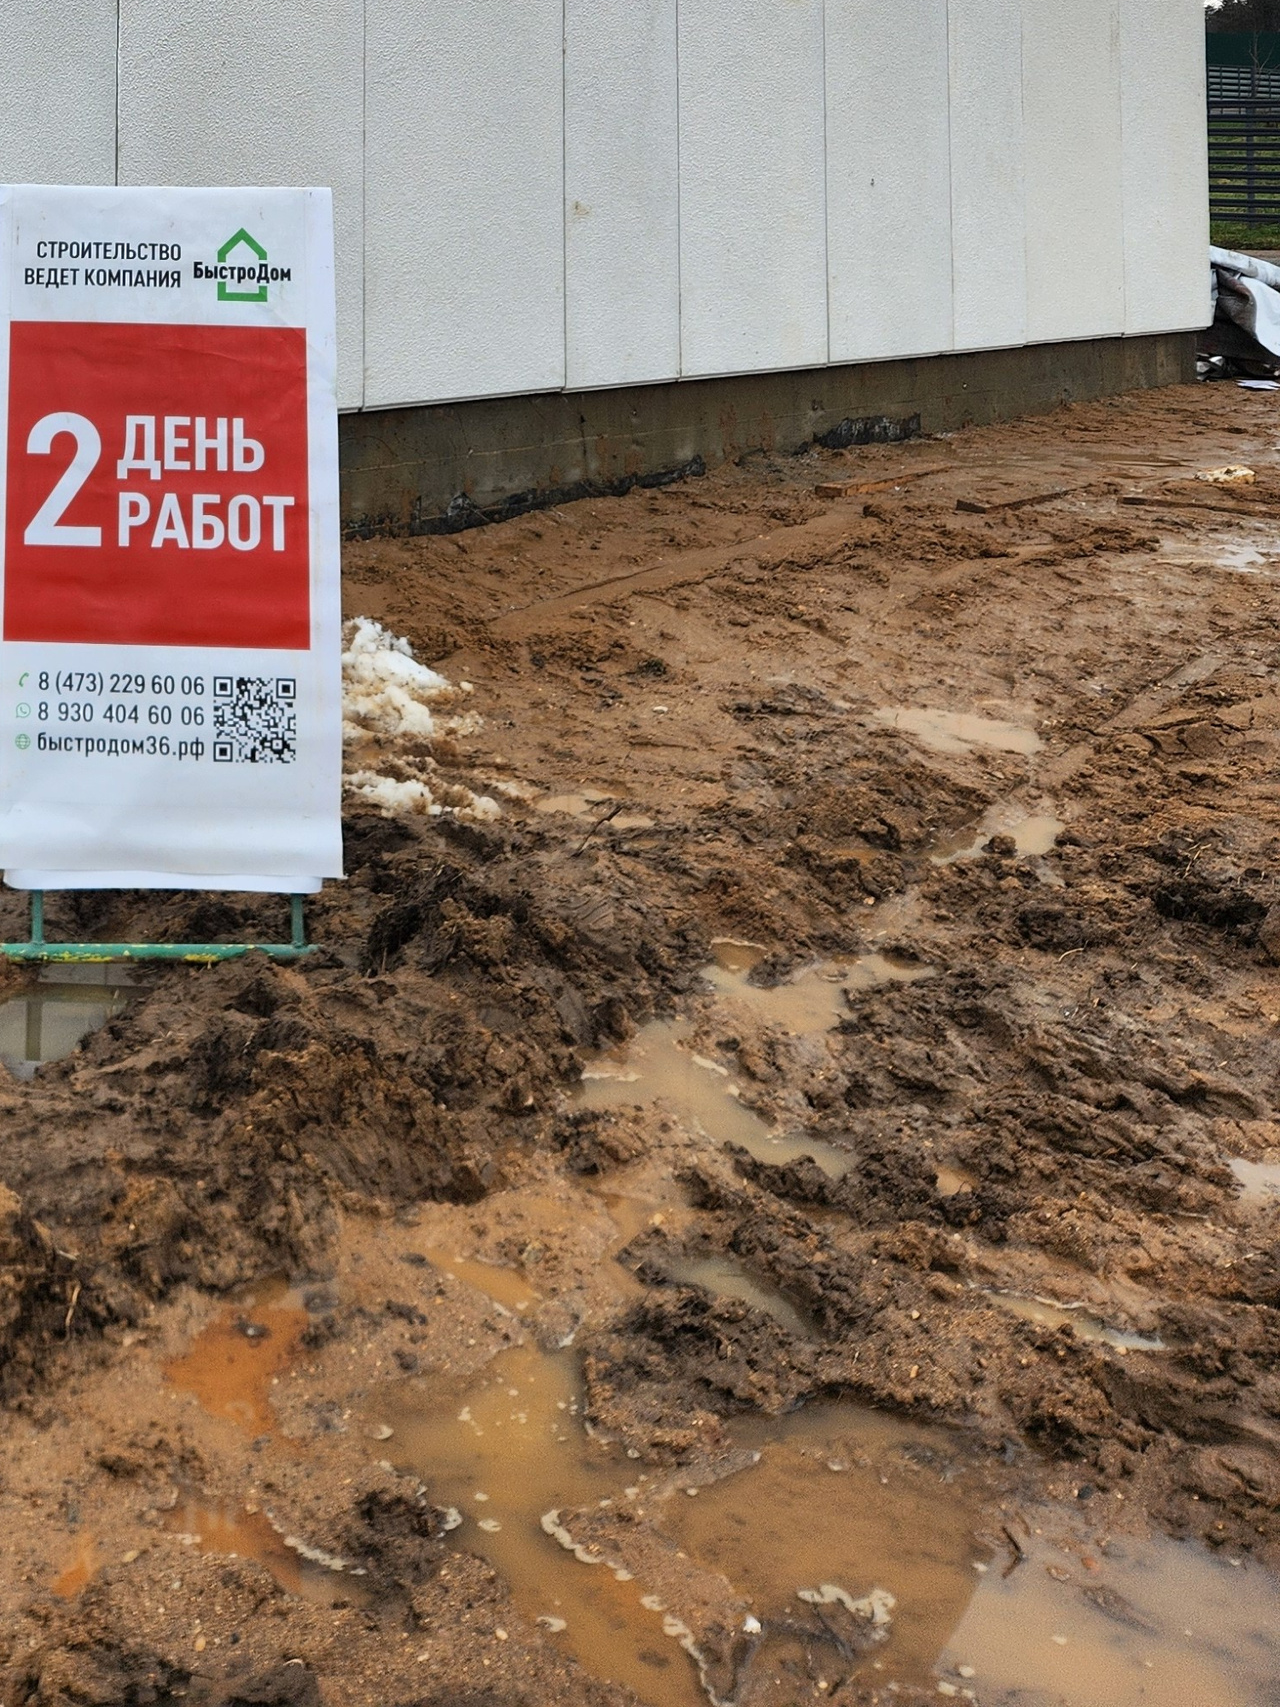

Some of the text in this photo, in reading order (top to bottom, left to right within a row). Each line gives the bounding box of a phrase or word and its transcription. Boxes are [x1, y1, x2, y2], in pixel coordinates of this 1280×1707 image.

[36, 240, 182, 262] СТРОИТЕЛЬСТВО
[24, 267, 181, 289] ВЕДЕТ КОМПАНИЯ
[193, 261, 292, 284] БыстроДом
[24, 412, 265, 547] 2 ДЕНЬ
[118, 491, 295, 552] РАБОТ
[38, 670, 205, 696] 8 (473) 229 60 06
[37, 701, 205, 726] 8 930 404 60 06
[37, 731, 205, 761] быстродом36.рф
